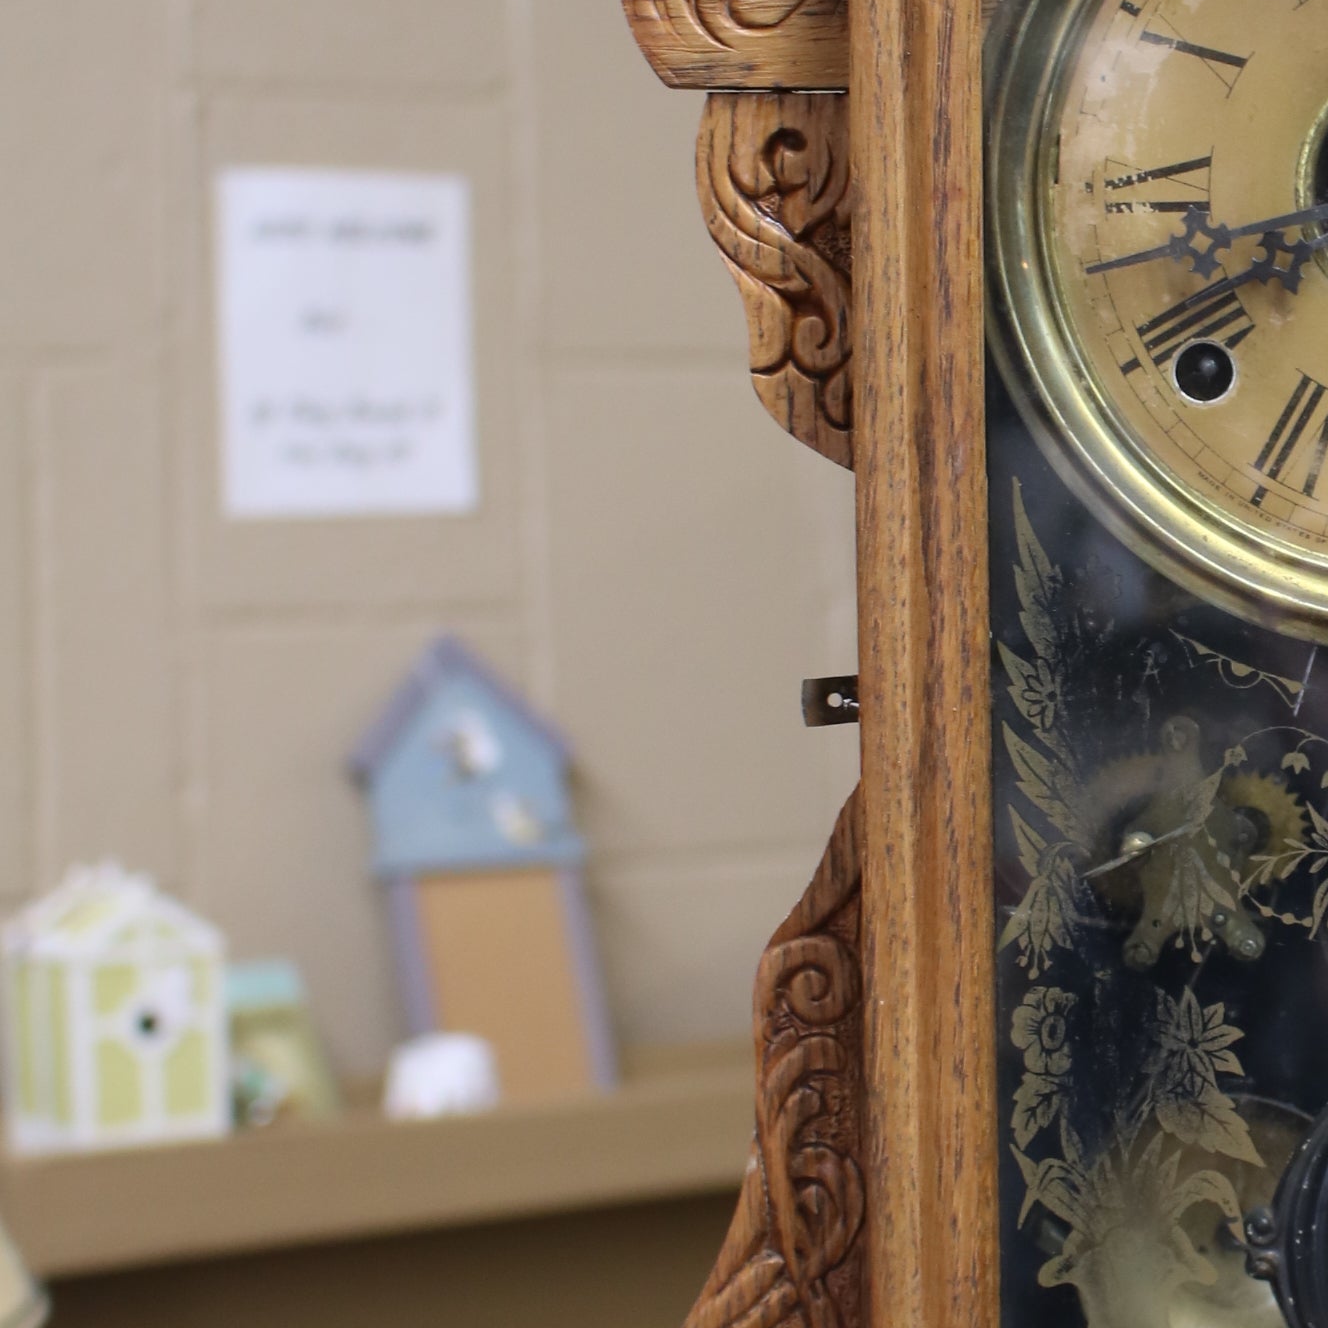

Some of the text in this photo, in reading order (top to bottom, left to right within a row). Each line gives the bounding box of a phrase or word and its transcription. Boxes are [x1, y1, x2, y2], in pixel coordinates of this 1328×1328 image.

[1105, 146, 1214, 223] IX
[1197, 470, 1221, 491] MADE
[1224, 491, 1236, 501] IN
[1238, 499, 1273, 523] UNITED
[1275, 520, 1311, 540] STATES
[1315, 536, 1327, 544] OF
